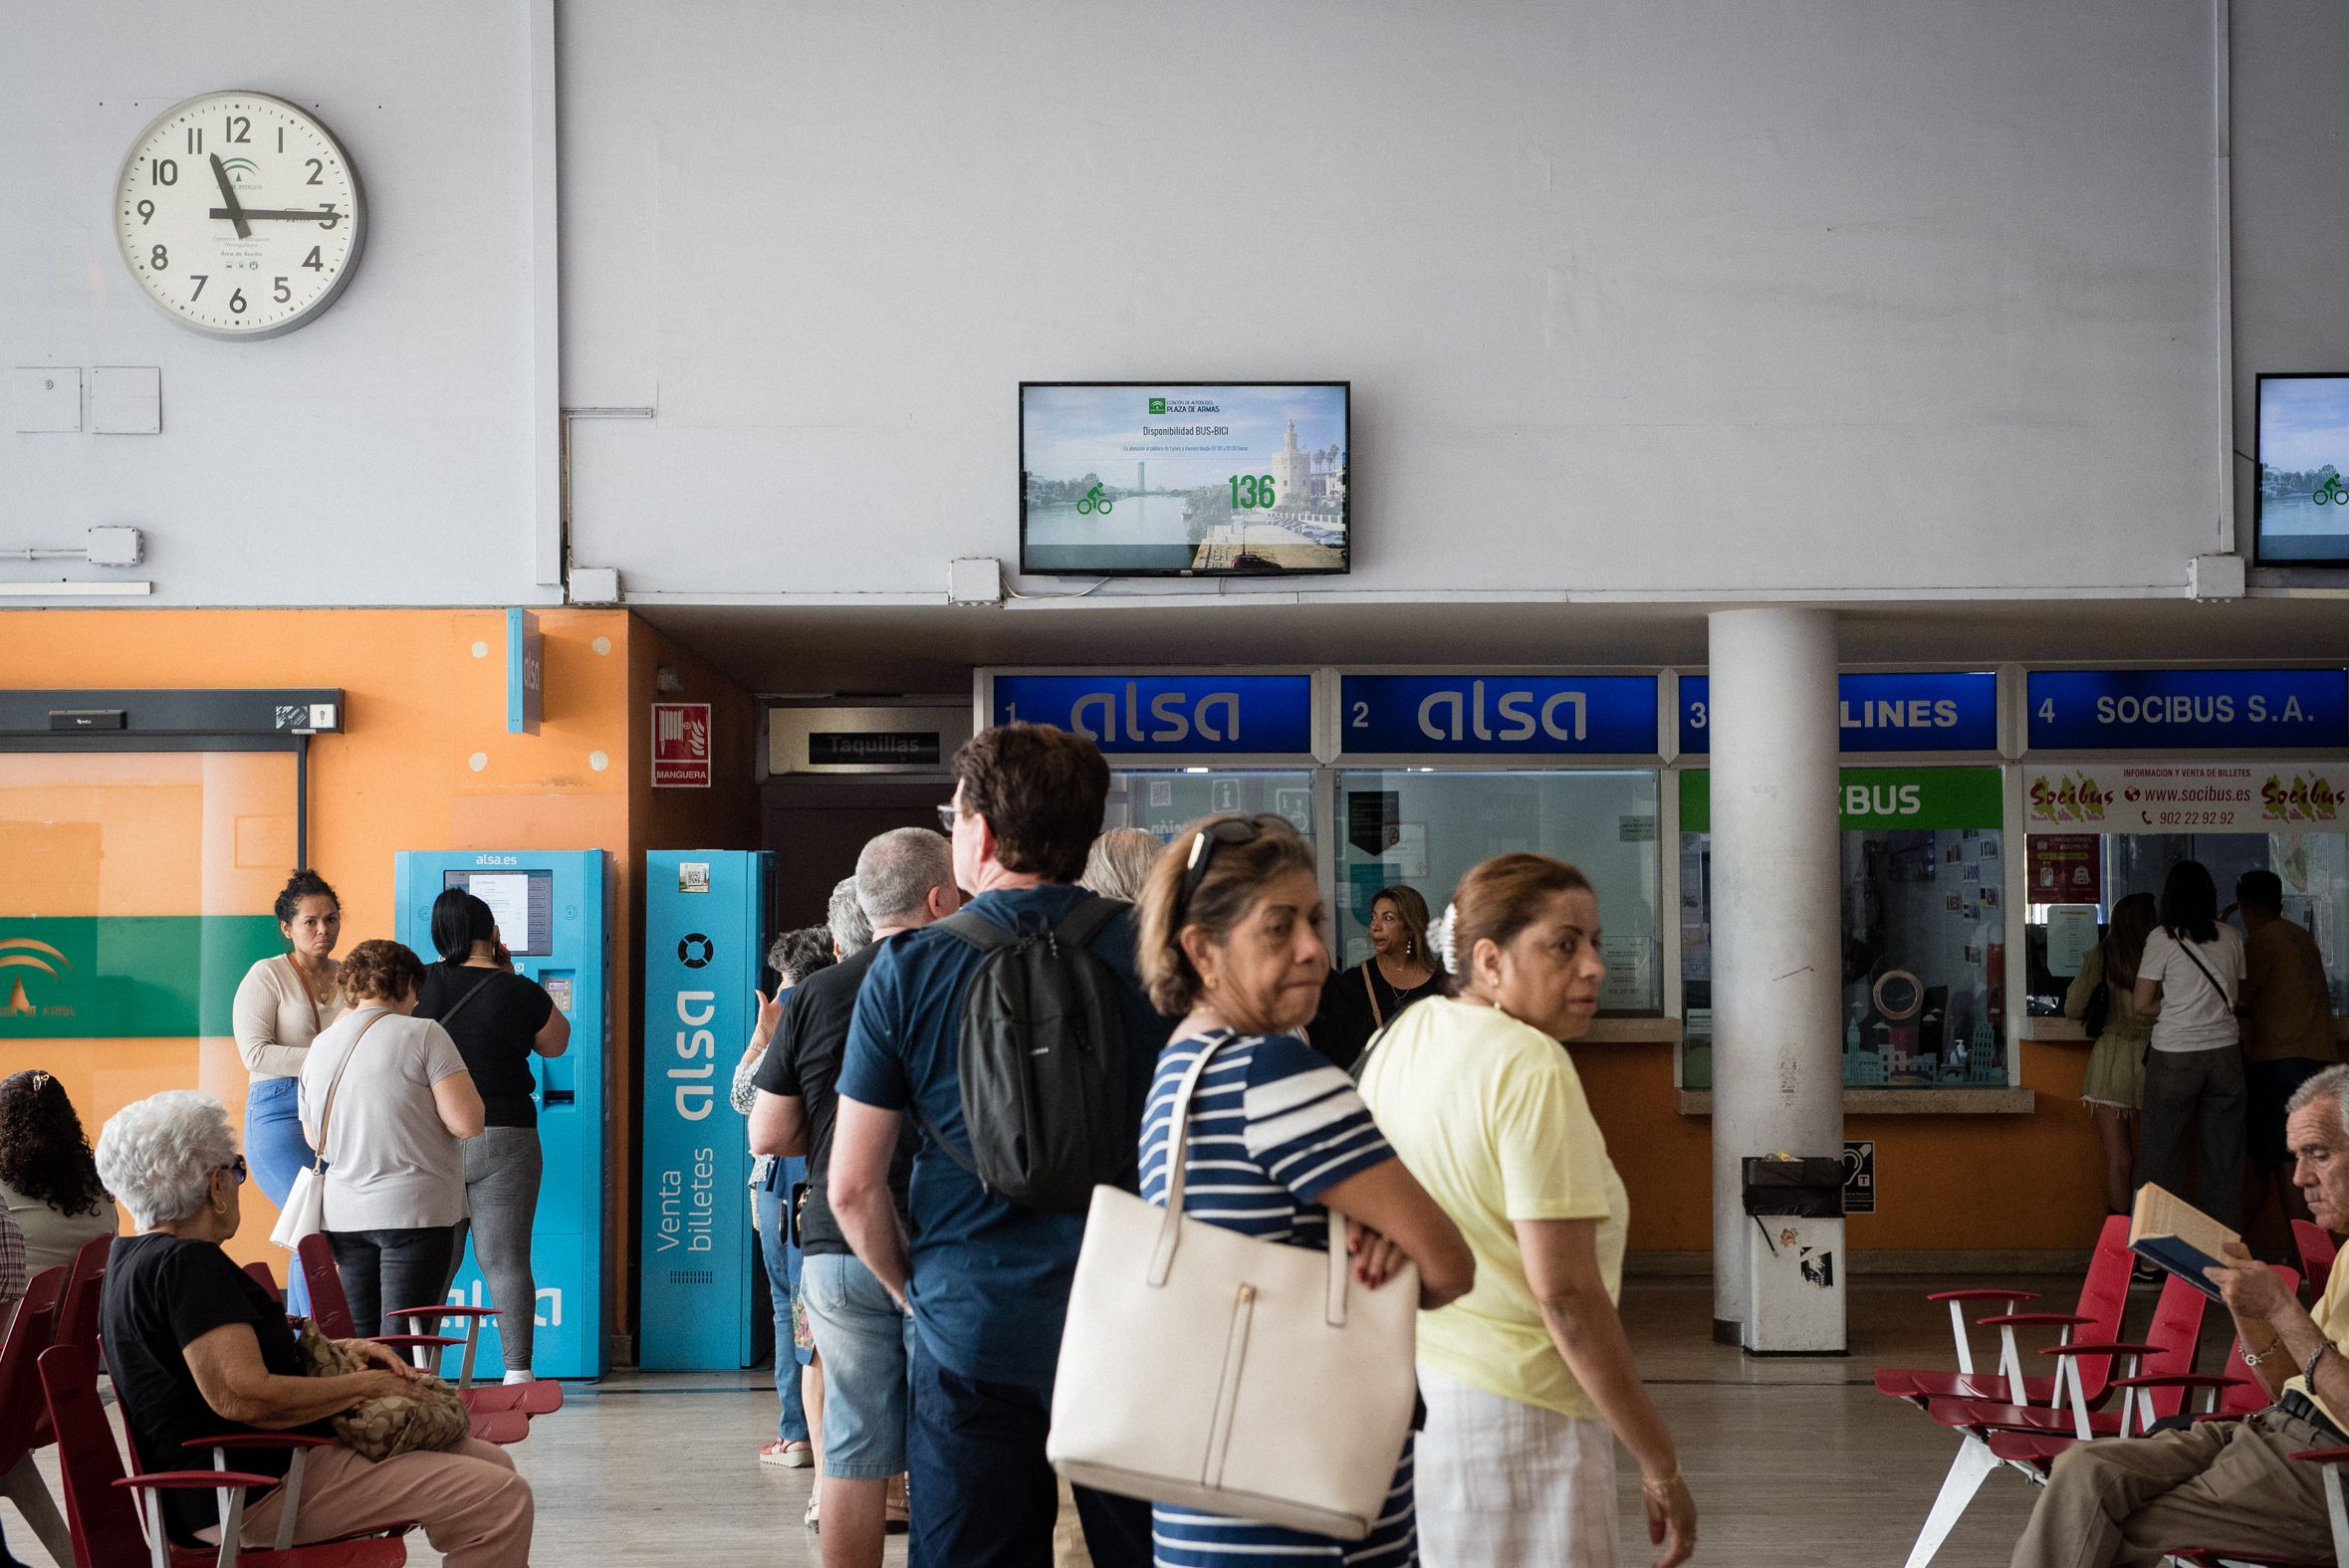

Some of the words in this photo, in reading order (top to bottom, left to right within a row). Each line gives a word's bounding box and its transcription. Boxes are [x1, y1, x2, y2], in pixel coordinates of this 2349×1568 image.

[187, 127, 203, 154] 11
[226, 116, 251, 142] 12
[278, 126, 284, 153] 1
[152, 159, 178, 186] 10
[305, 158, 324, 185] 2
[136, 199, 155, 225] 9
[318, 203, 339, 230] 3
[150, 244, 169, 271] 8
[301, 245, 324, 272] 4
[189, 275, 209, 302] 7
[229, 287, 247, 314] 6
[273, 277, 292, 304] 5
[1143, 426, 1194, 437] Disponibilidad
[1229, 474, 1276, 510] 136
[523, 652, 540, 690] alsa
[1069, 681, 1240, 743] alsa
[1352, 701, 1370, 729] 2
[1417, 679, 1587, 742] alsa
[1690, 702, 1707, 729] 3
[2038, 698, 2056, 724] 4
[2096, 695, 2235, 724] SOCIBUS
[827, 735, 920, 757] Taquillas
[656, 770, 707, 781] MANGUERA
[2123, 769, 2174, 778] INFORMACION
[2182, 769, 2206, 778] VENTA
[2206, 769, 2217, 778] DE
[2218, 769, 2251, 778] BILLETES
[1839, 784, 1921, 815] BUS
[2029, 781, 2115, 806] Socibus
[2145, 784, 2251, 802] www.socibus.es
[2260, 779, 2346, 806] Socibus
[2160, 811, 2182, 825] 902
[2185, 811, 2201, 824] 22
[2202, 811, 2217, 824] 92
[2219, 811, 2234, 824] 92
[476, 854, 517, 865] alsa.es
[666, 991, 715, 1121] alsa
[1859, 1176, 1868, 1185] T
[657, 1170, 682, 1252] Venta
[688, 1147, 713, 1251] billetes
[440, 1278, 562, 1328] ala
